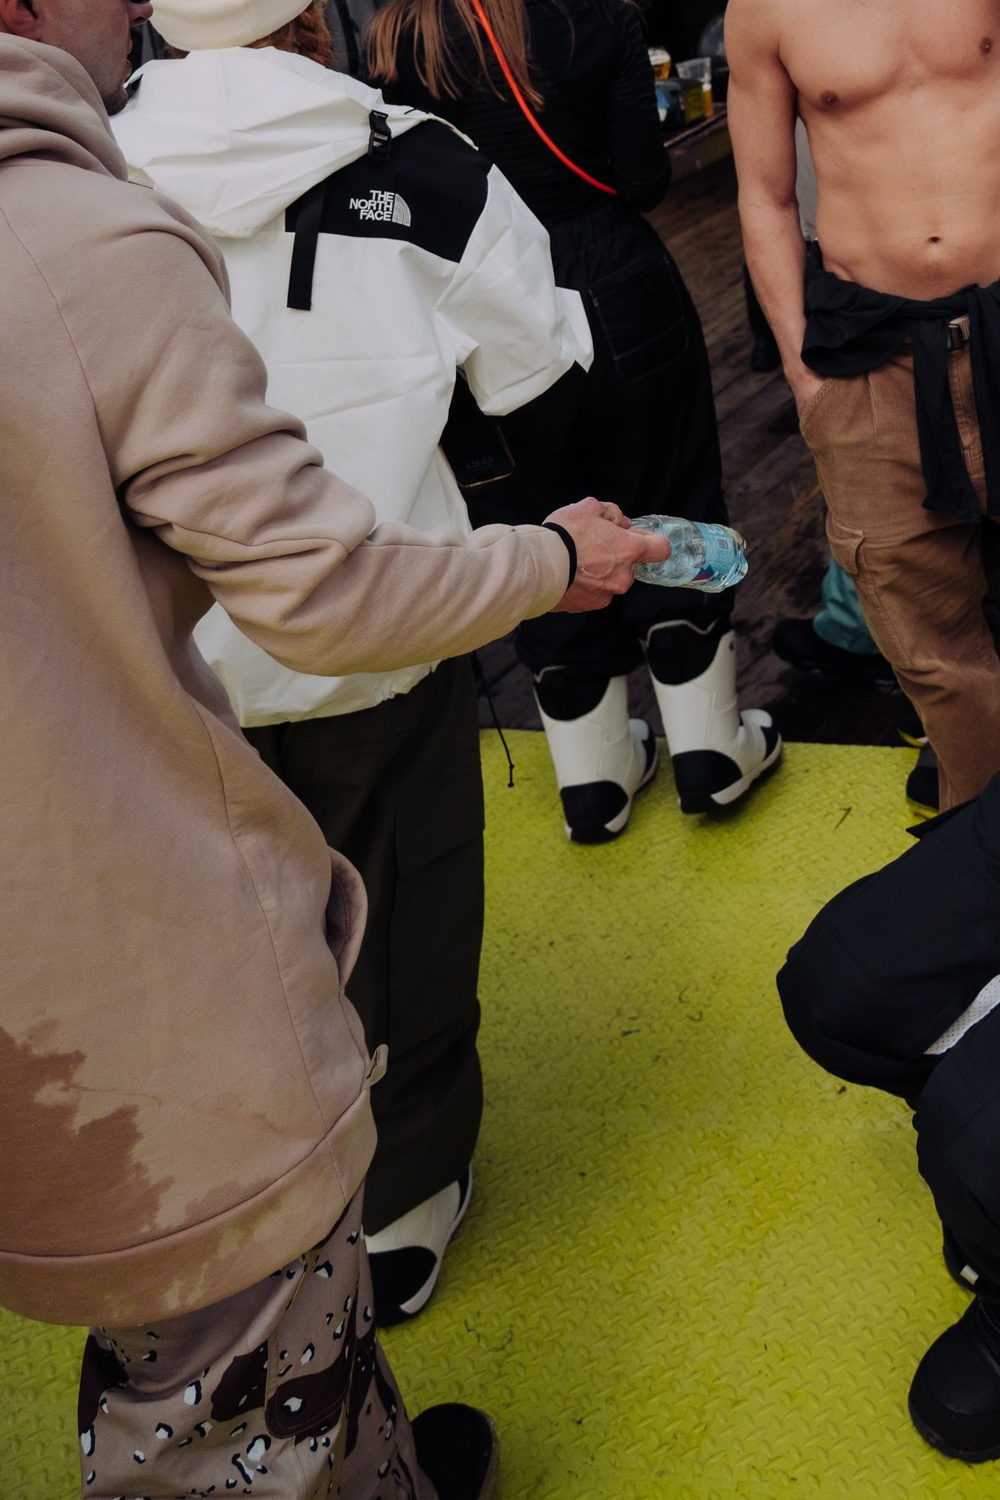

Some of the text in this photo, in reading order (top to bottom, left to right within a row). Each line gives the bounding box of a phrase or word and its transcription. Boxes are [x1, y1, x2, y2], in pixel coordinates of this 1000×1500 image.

[369, 189, 395, 202] THE
[349, 198, 394, 212] NORTH
[359, 209, 393, 221] FACE
